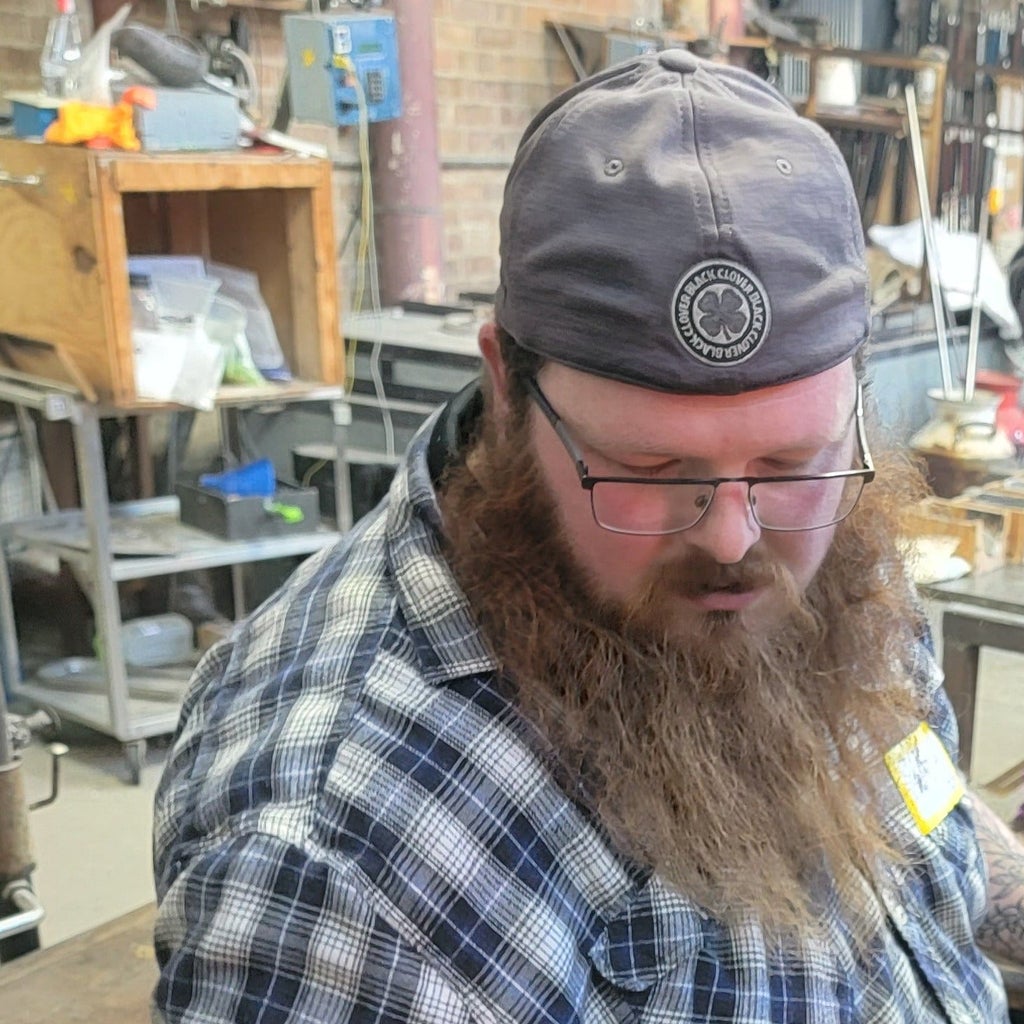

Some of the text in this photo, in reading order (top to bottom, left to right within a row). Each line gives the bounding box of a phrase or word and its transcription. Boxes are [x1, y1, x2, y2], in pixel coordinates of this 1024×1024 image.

[684, 268, 754, 296] BLACK CLOVER
[679, 294, 723, 359] BLACK CLOVER
[725, 292, 764, 359] BLACK CLOVER
